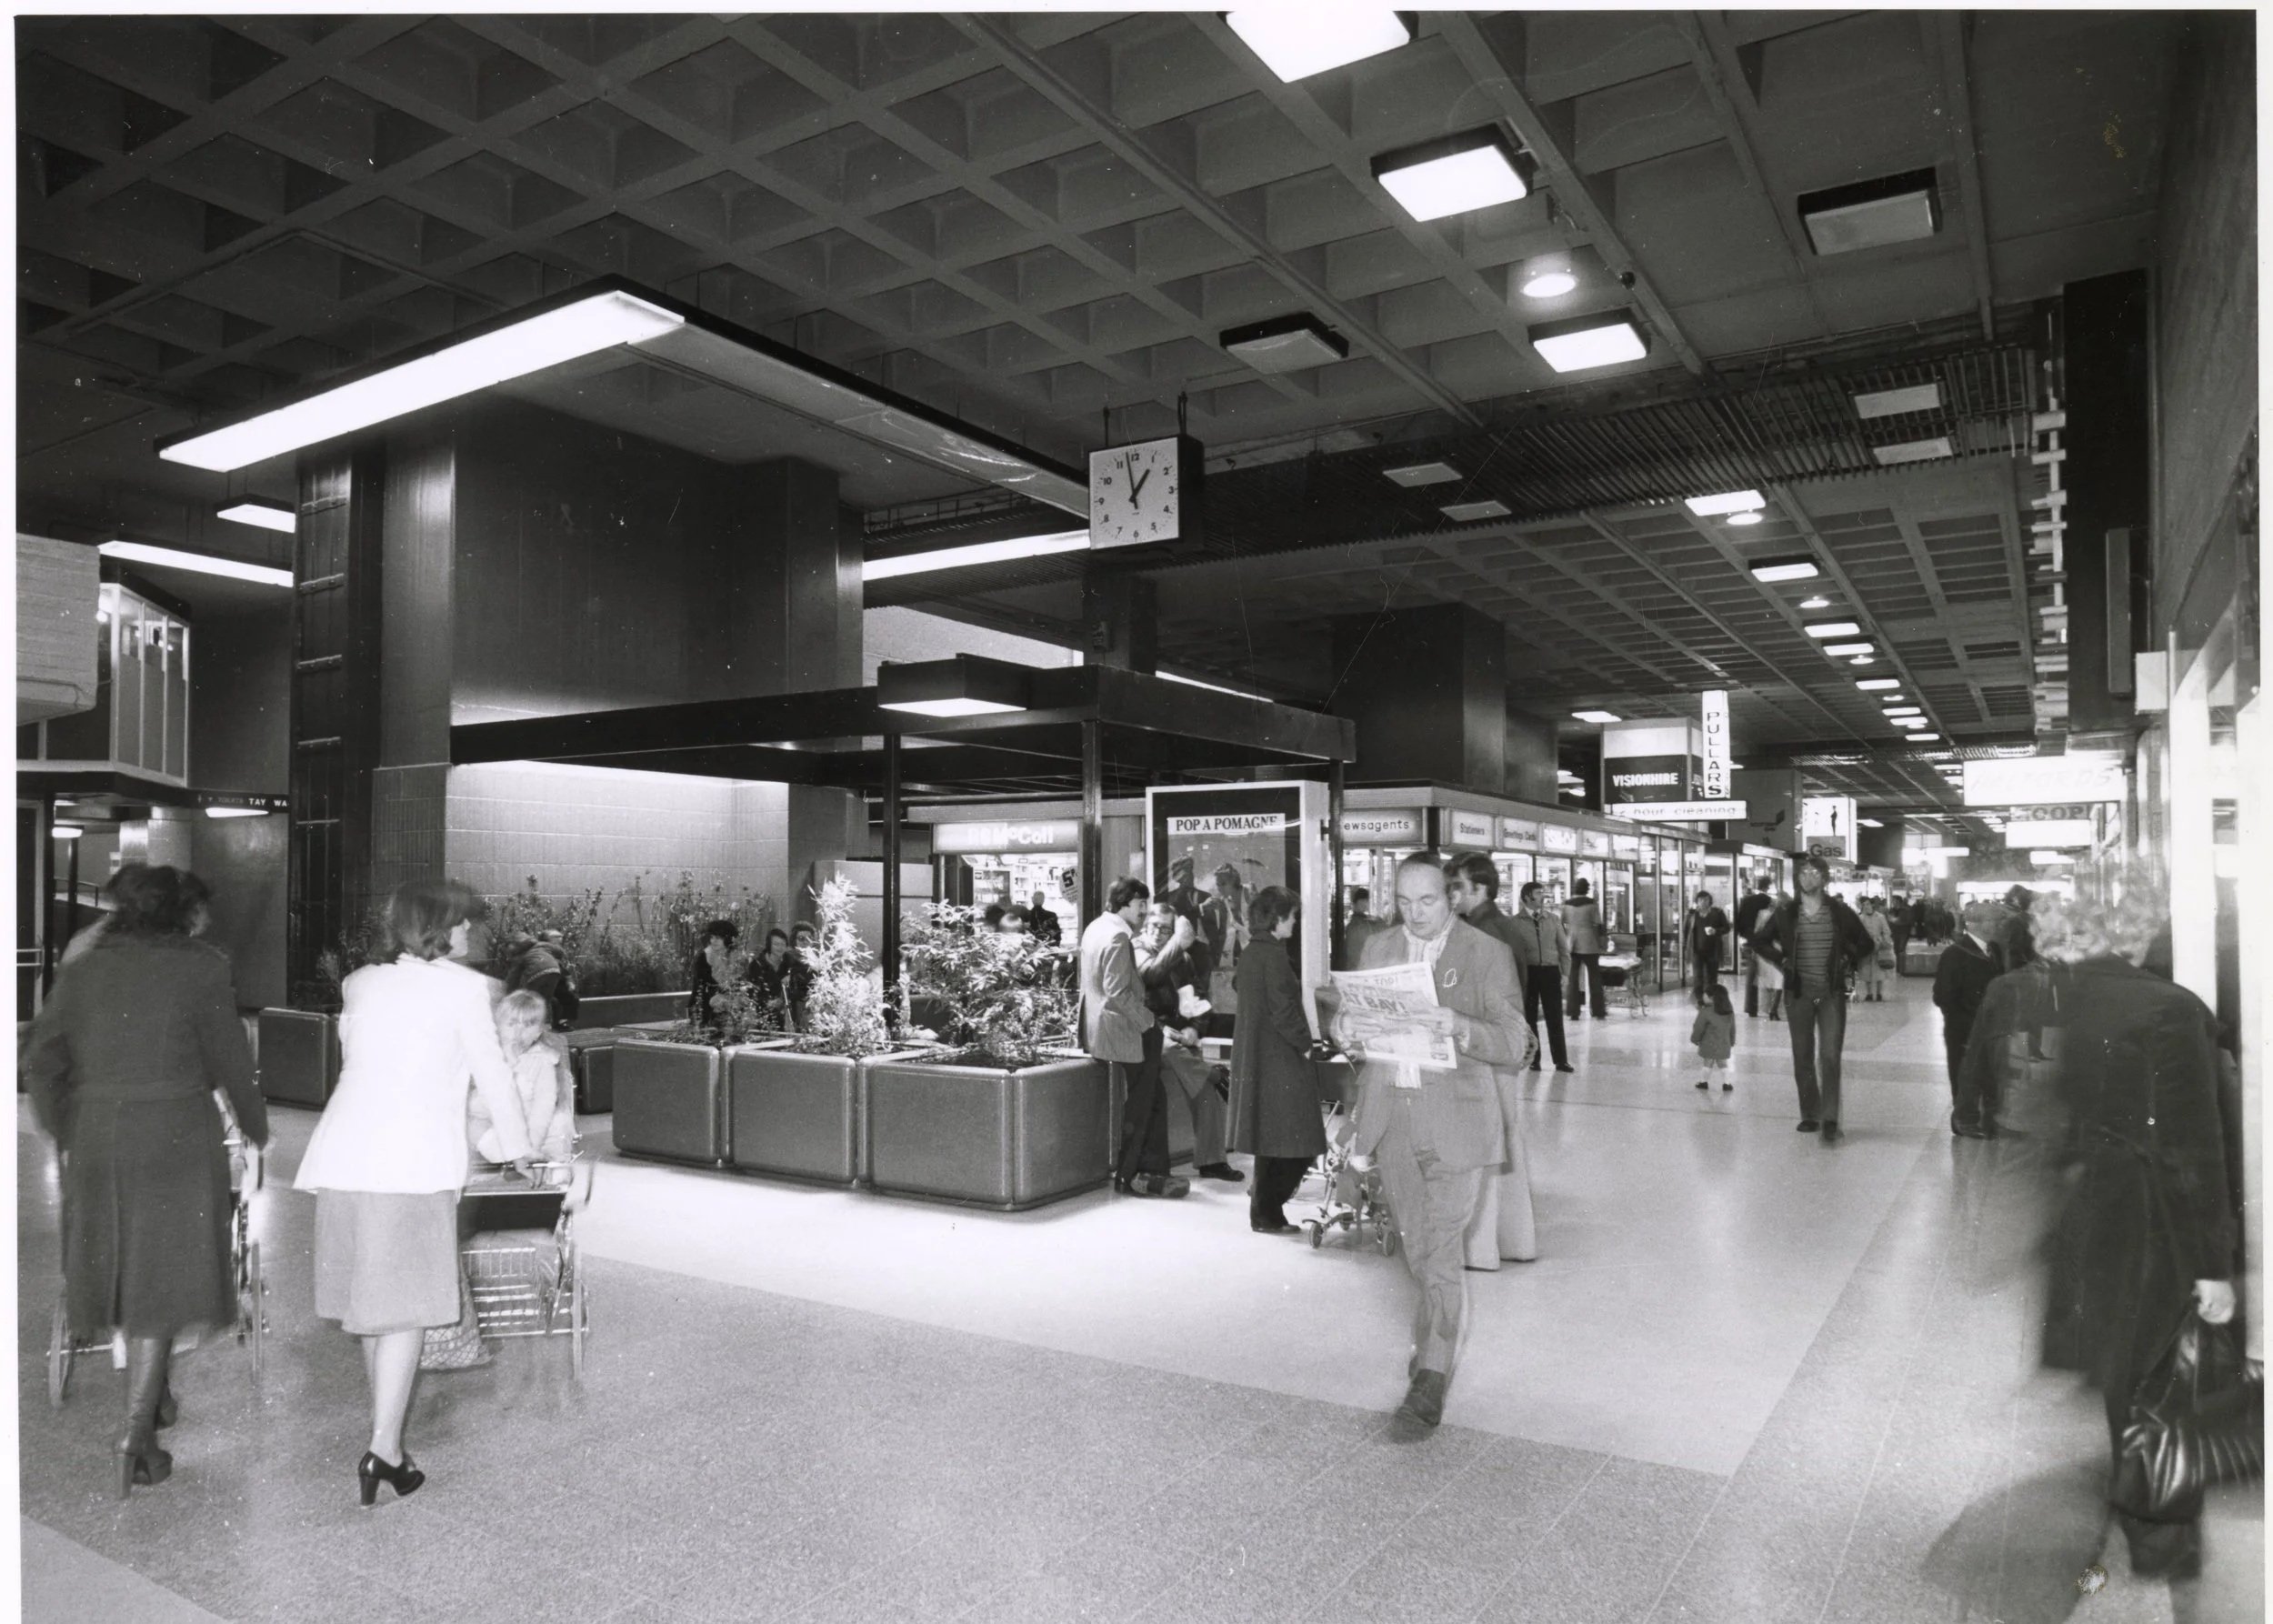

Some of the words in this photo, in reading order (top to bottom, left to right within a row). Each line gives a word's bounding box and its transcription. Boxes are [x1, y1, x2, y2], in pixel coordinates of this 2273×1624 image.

[1131, 453, 1140, 462] 12
[1116, 461, 1124, 469] 11
[1164, 467, 1169, 476] 2
[1103, 477, 1112, 486] 10
[1168, 486, 1175, 495] 3
[1098, 497, 1105, 506] 9
[1163, 505, 1169, 513] 4
[1103, 515, 1109, 523] 8
[1117, 526, 1124, 535] 7
[1151, 522, 1157, 530] 5
[1133, 530, 1139, 538] 6
[1707, 711, 1722, 796] PULLARS
[1612, 772, 1678, 787] VISIONHIRE
[248, 797, 266, 806] TAY
[273, 799, 289, 807] WA
[1633, 806, 1666, 816] hour
[1674, 806, 1736, 817] cleaning
[1176, 819, 1201, 832] POP
[1202, 818, 1211, 831] A
[1214, 816, 1277, 830] POMAGNE
[1343, 819, 1410, 833] ewsagents
[1810, 843, 1842, 857] Gas
